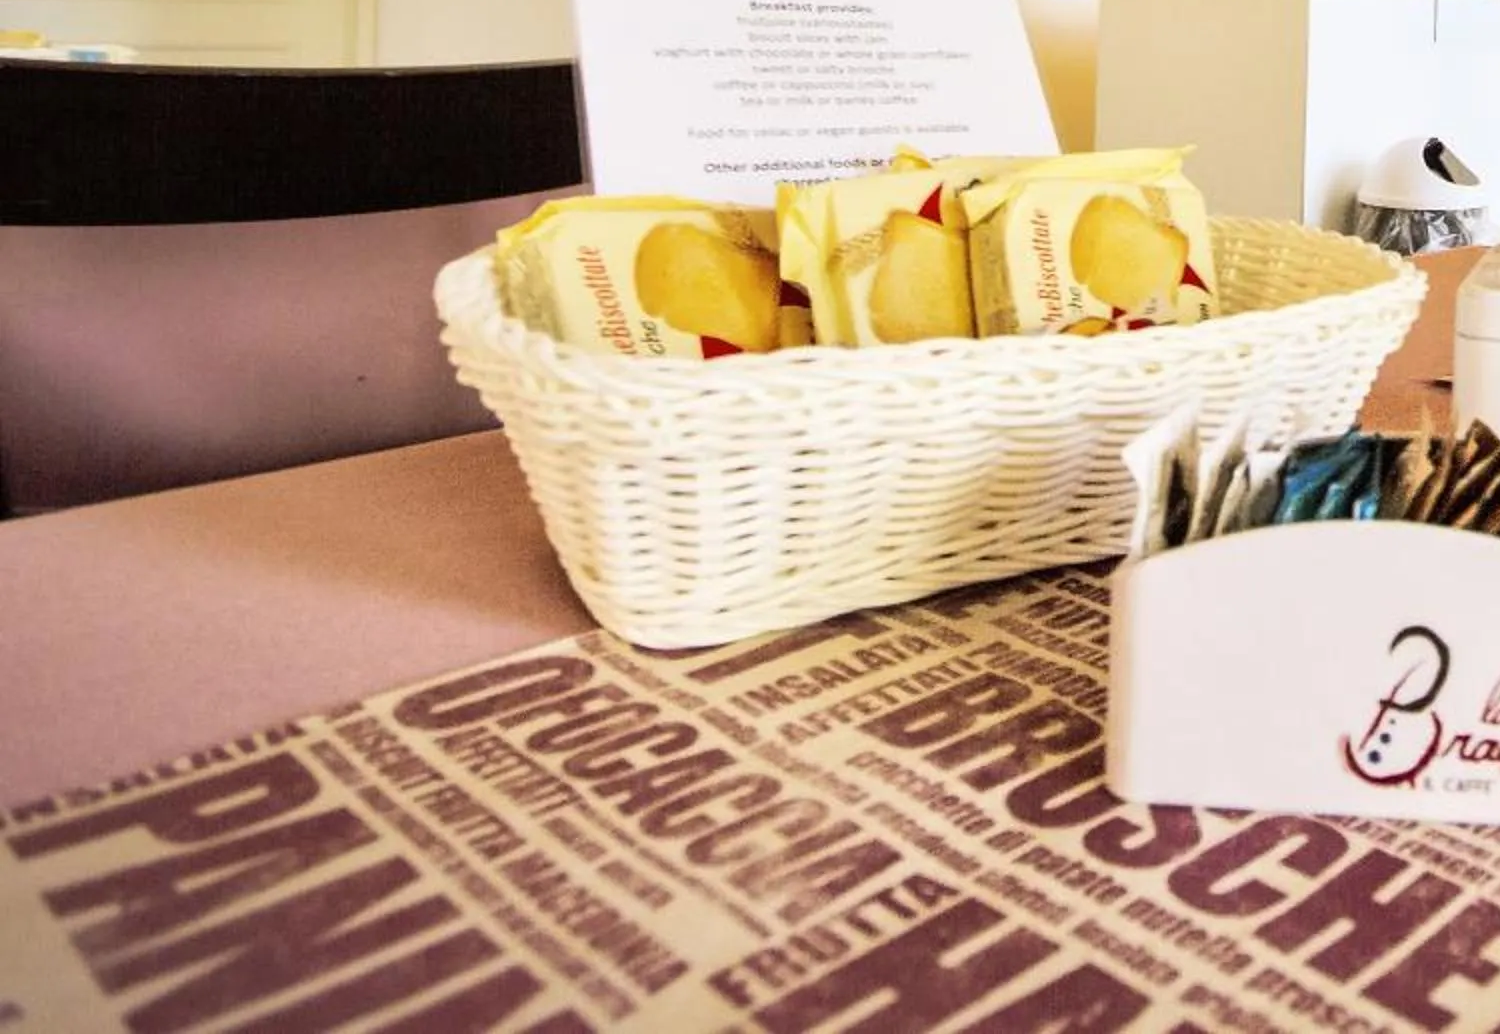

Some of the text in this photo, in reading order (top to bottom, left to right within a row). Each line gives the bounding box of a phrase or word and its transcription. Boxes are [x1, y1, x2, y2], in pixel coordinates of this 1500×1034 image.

[703, 161, 748, 174] Other
[752, 158, 824, 172] additional
[828, 156, 868, 170] foods
[870, 157, 884, 168] or
[728, 632, 943, 717] INSALATA
[778, 656, 986, 745] AFFETTATI
[704, 872, 962, 1008] FRUTTA
